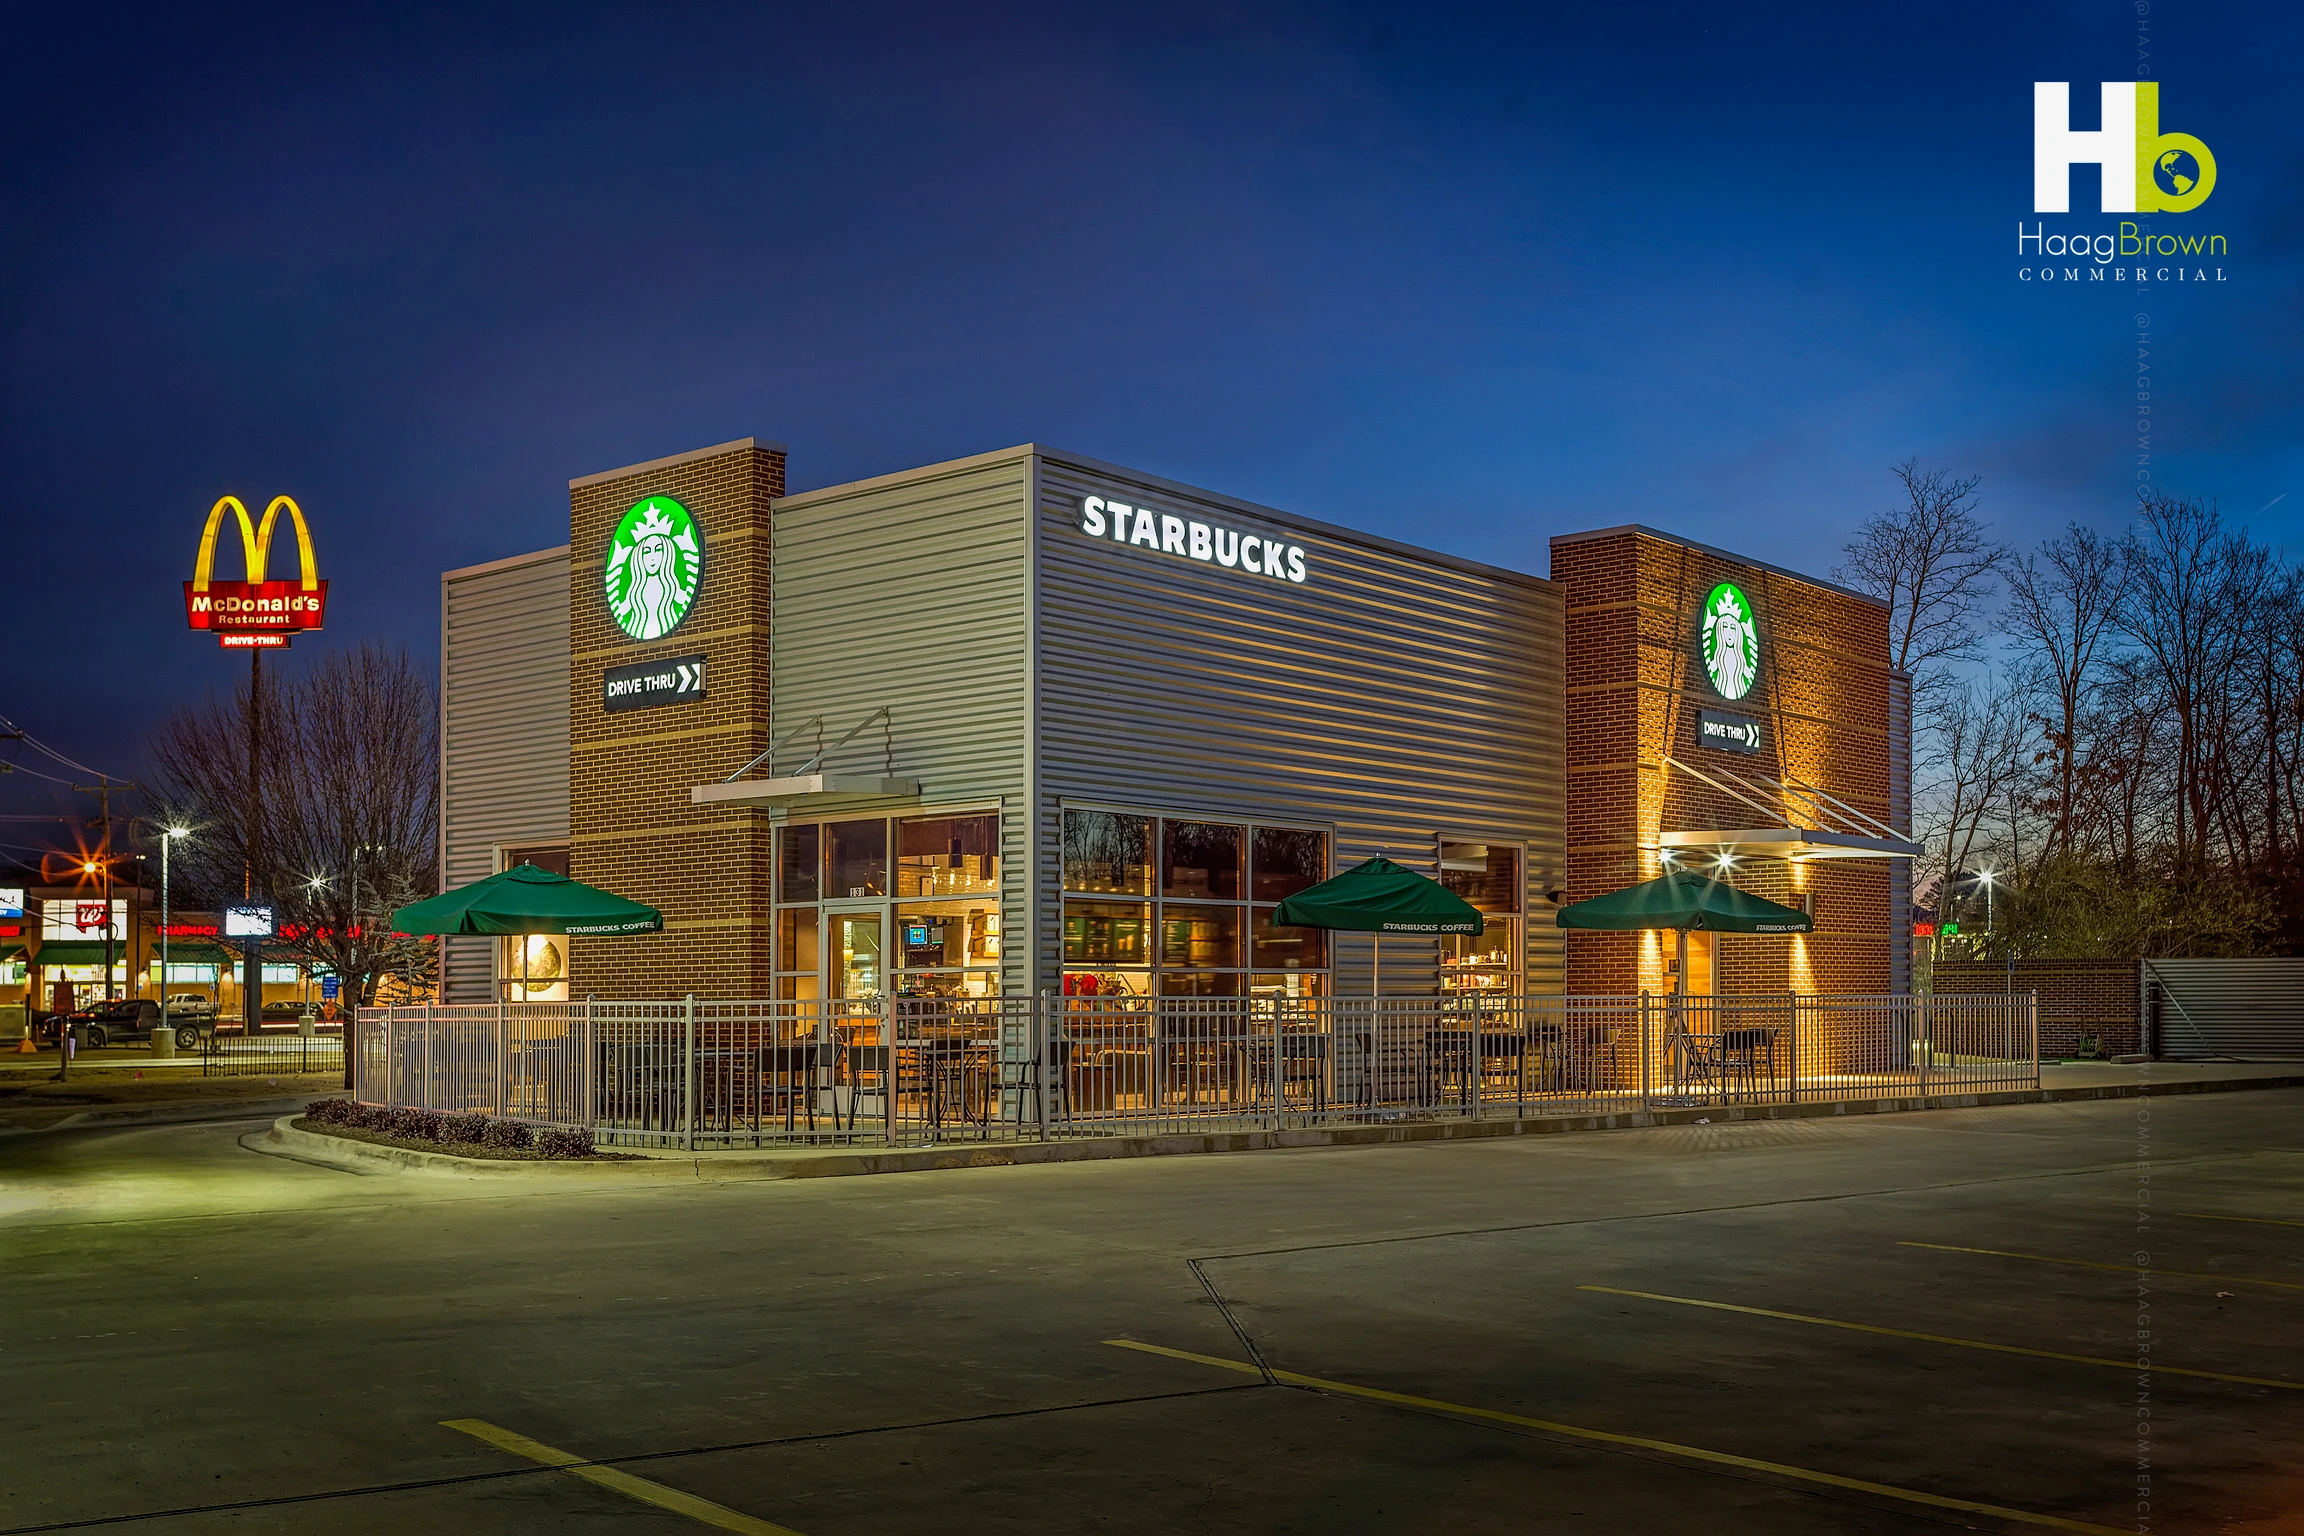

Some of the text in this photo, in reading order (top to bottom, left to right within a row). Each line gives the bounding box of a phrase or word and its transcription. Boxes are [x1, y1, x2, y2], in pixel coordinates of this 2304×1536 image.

[1082, 495, 1307, 583] STARBUCKS
[191, 596, 320, 612] McDonald's
[218, 615, 290, 624] Restaurant
[608, 672, 676, 697] DRIVE THRU
[1704, 721, 1746, 741] DRIVE THRU
[565, 921, 655, 934] STARBUCKS COFFEE
[1383, 923, 1474, 931] STARBUCKS COFFEE
